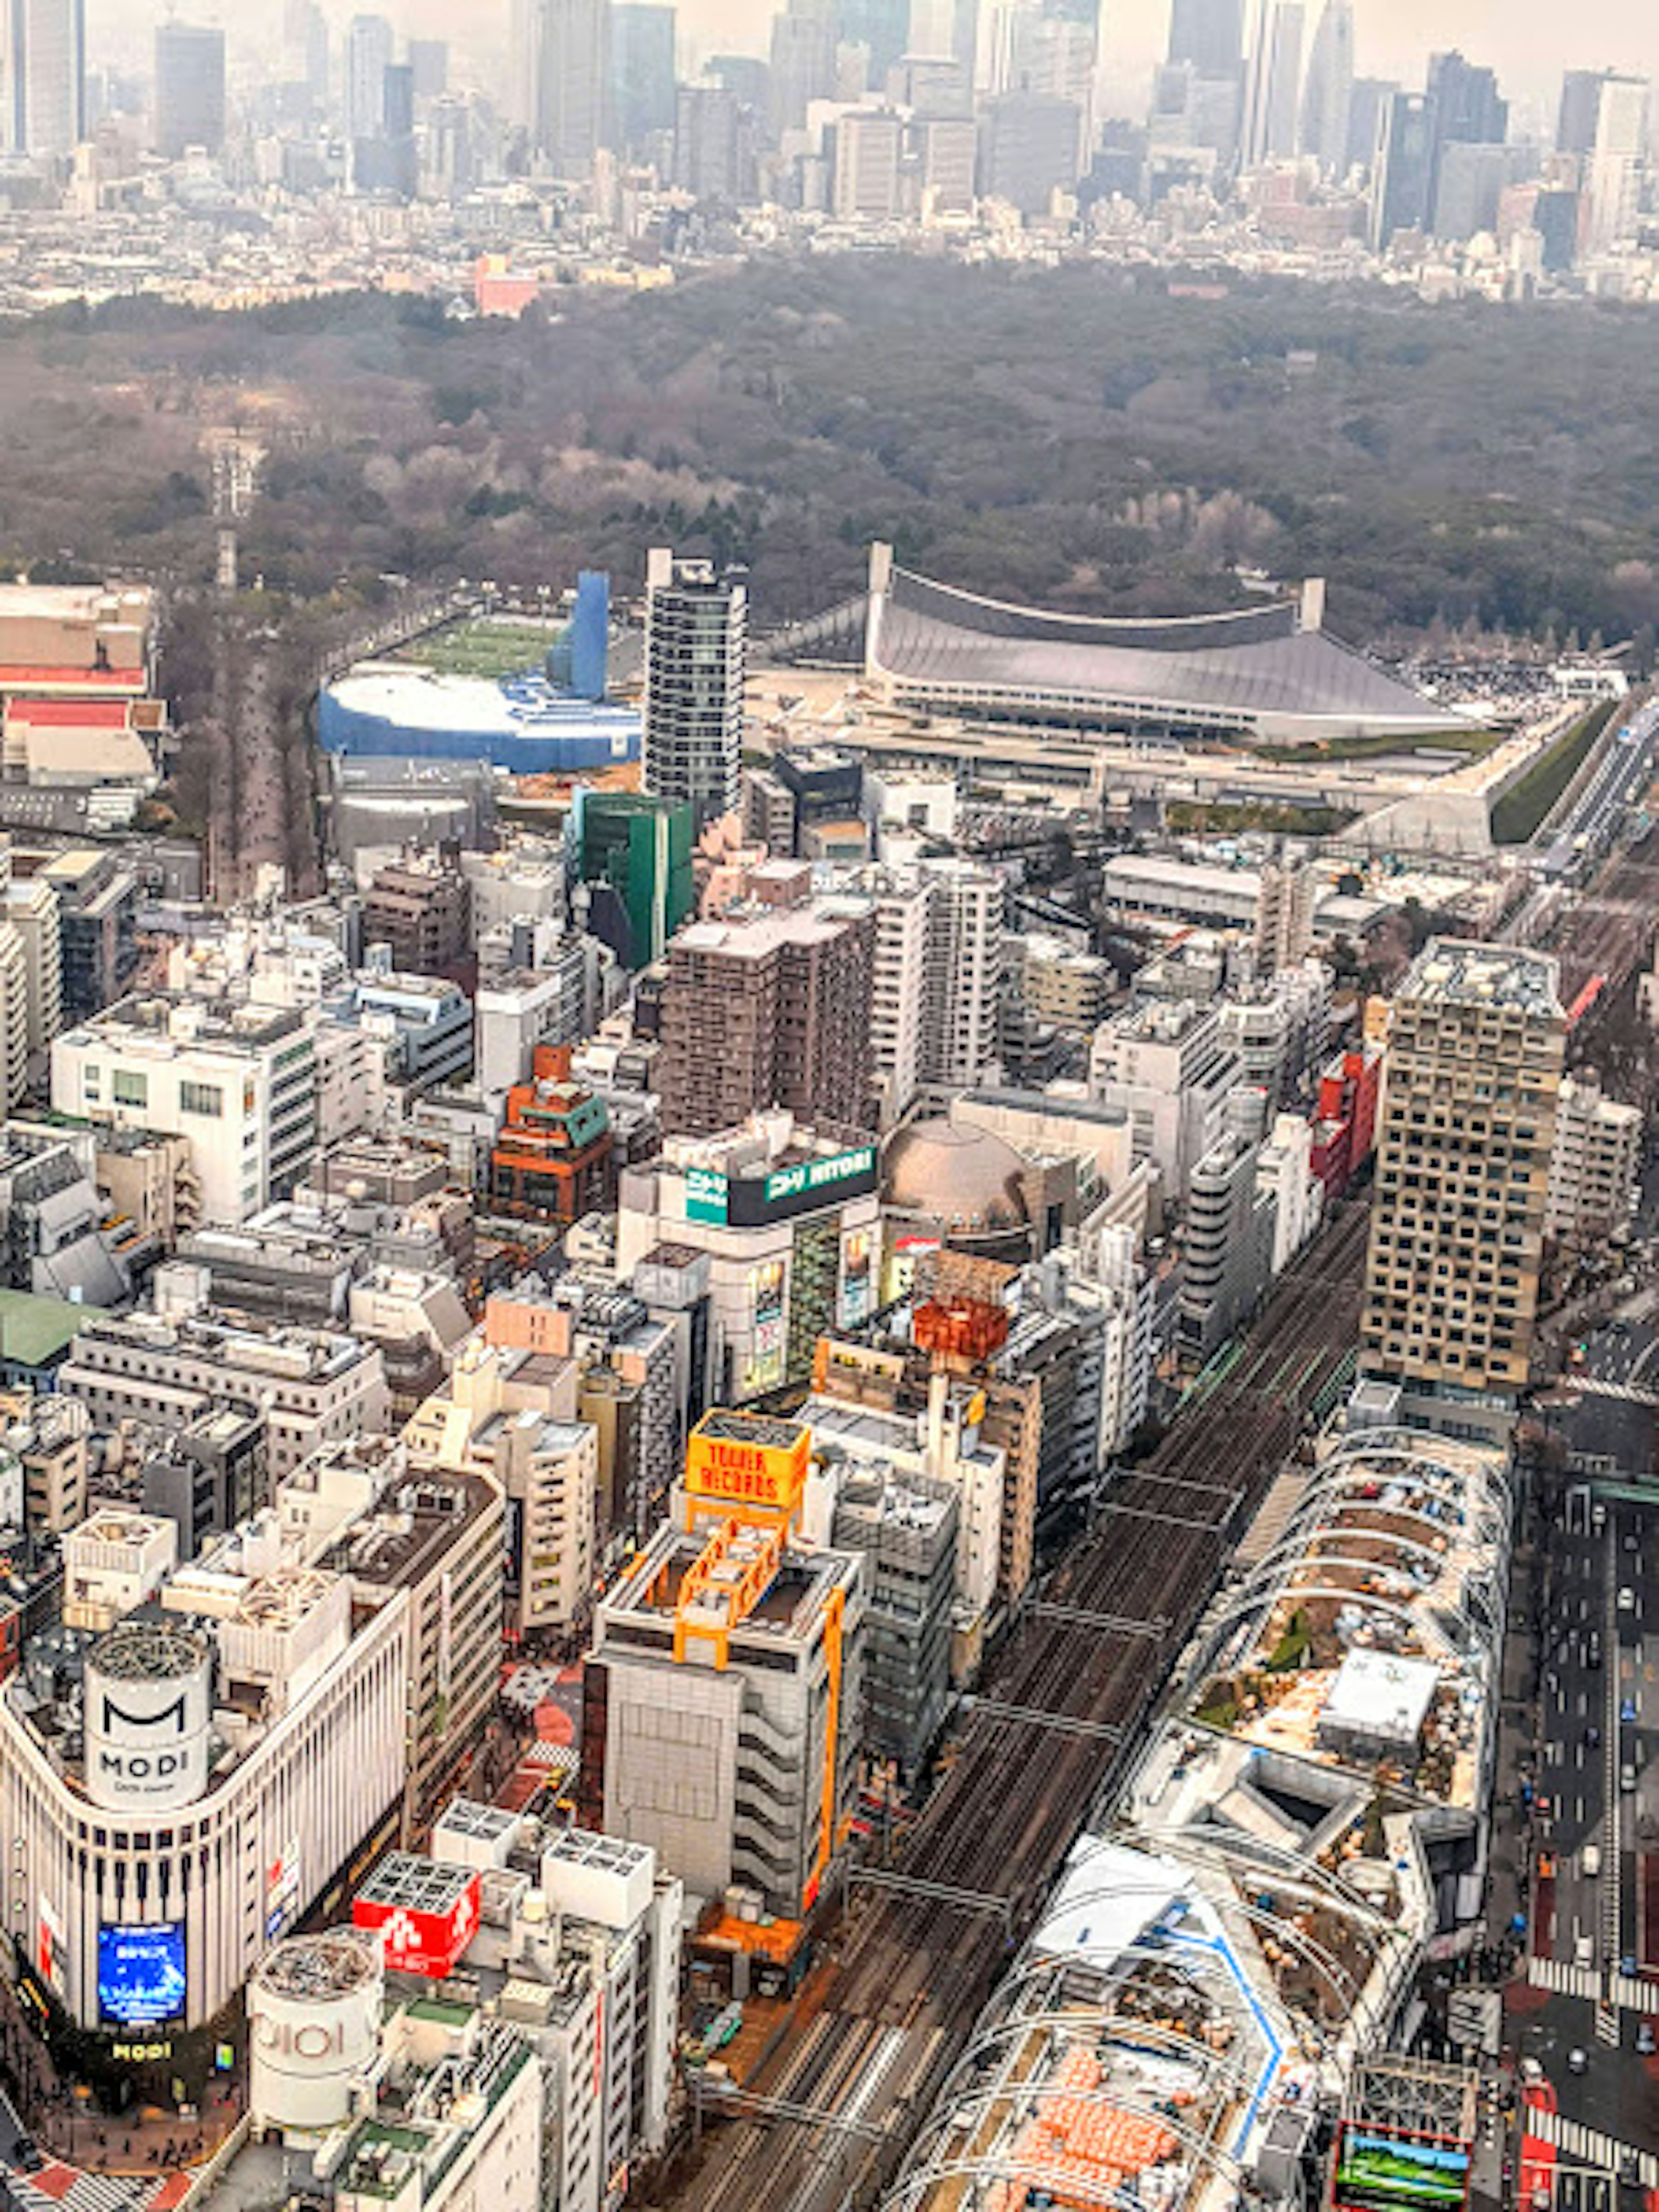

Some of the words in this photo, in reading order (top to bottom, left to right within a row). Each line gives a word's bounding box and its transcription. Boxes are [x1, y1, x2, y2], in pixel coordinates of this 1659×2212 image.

[809, 1149, 872, 1185] NITORI
[701, 1468, 778, 1500] RECORDS
[100, 1751, 188, 1777] MODI
[113, 2041, 172, 2063] MODI
